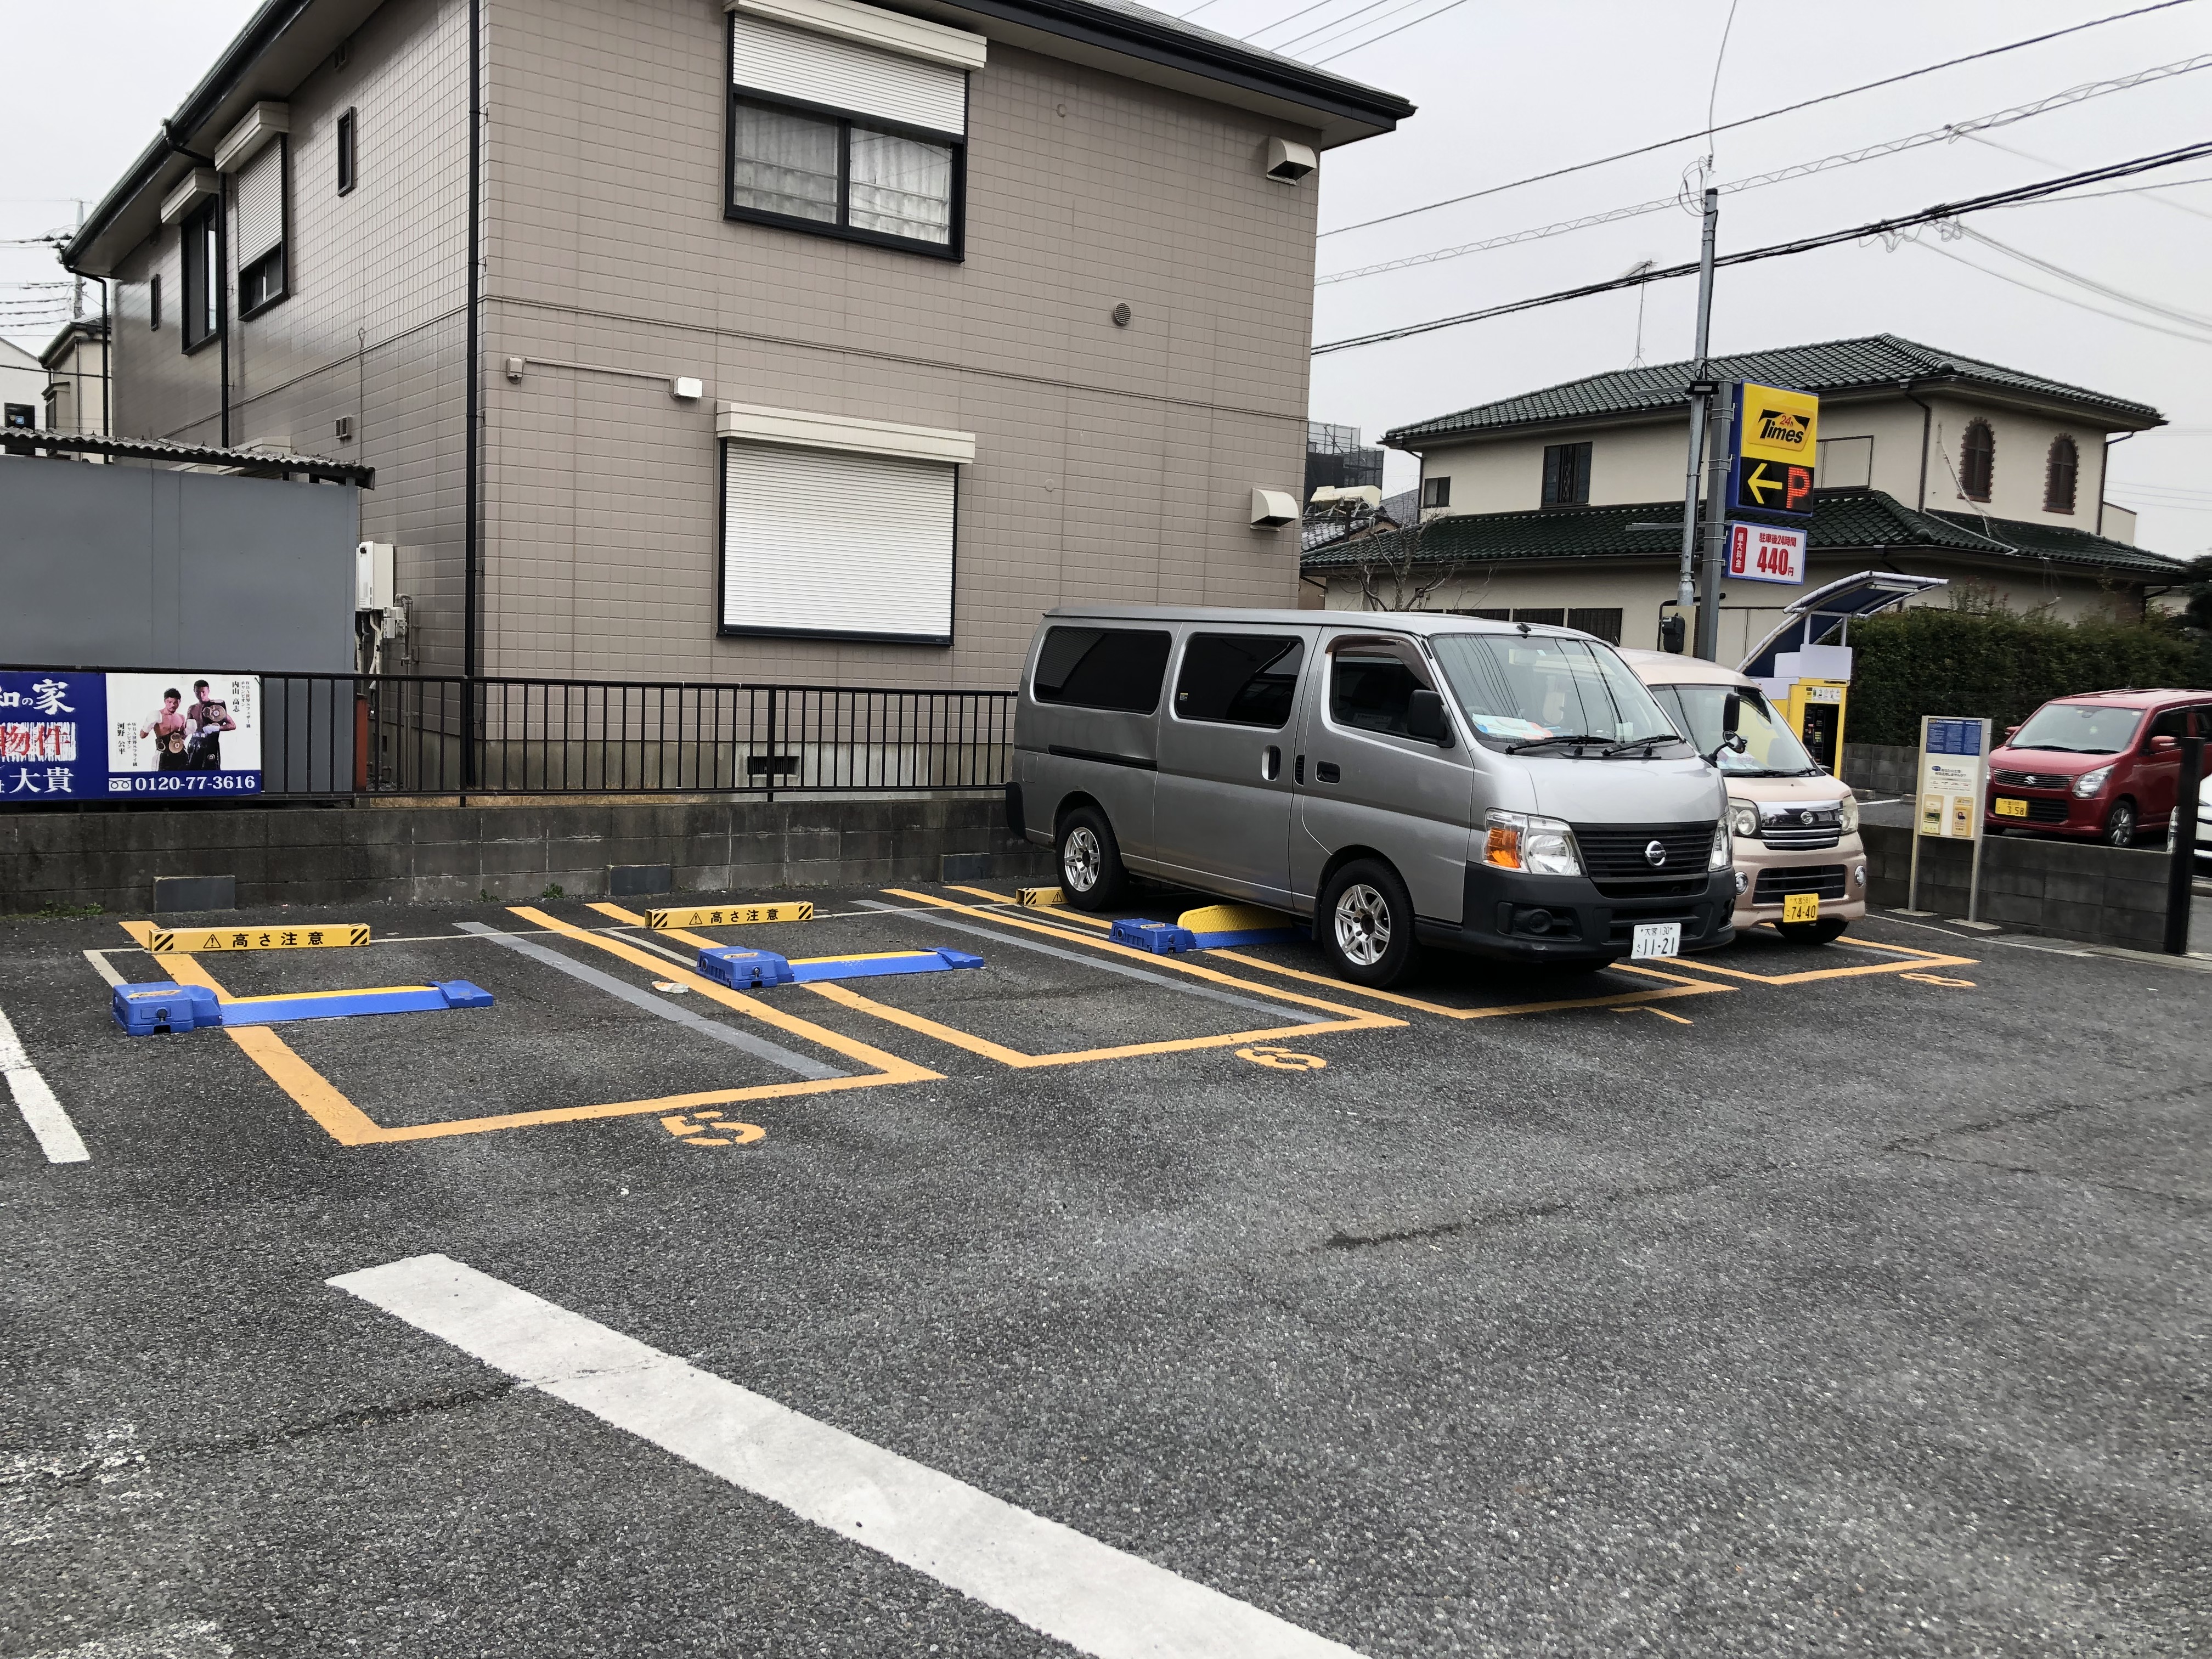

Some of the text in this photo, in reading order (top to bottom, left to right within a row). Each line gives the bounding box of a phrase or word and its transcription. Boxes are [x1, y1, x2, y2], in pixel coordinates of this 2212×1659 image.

[1780, 415, 1793, 427] 24h
[1759, 419, 1804, 444] Times
[1786, 467, 1811, 509] P
[1759, 532, 1797, 548] 駐車後24時間
[1735, 533, 1744, 568] 最大料金
[135, 775, 256, 791] 0120-77-3616
[710, 908, 780, 924] 高さ注意
[1792, 905, 1816, 919] 74-40
[232, 931, 324, 948] 高さ注意
[1643, 937, 1674, 956] 11-21
[1234, 1046, 1328, 1071] 6
[659, 1110, 767, 1147] 5
